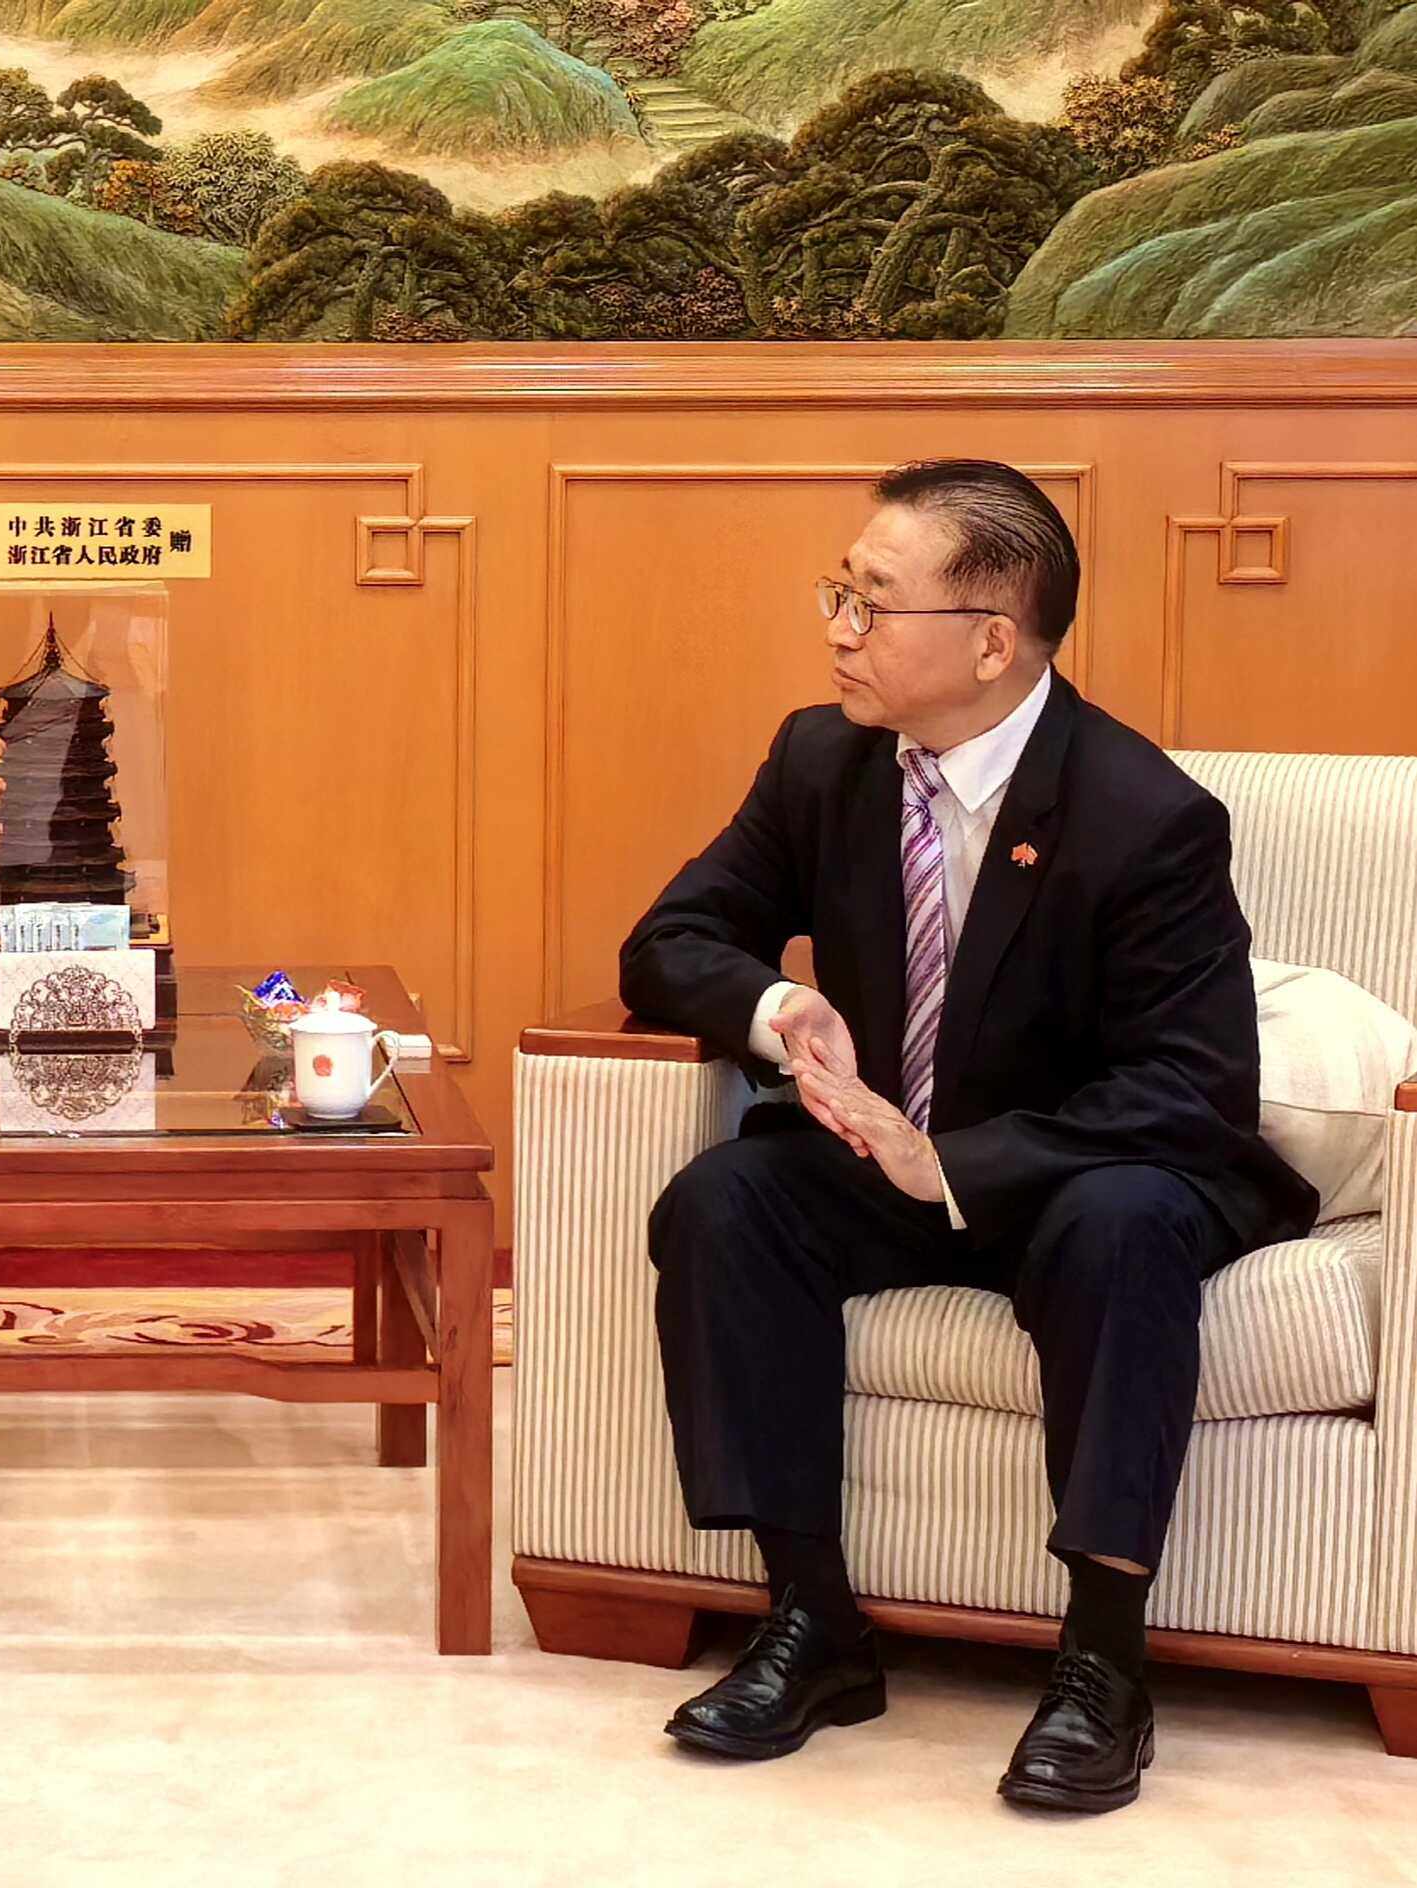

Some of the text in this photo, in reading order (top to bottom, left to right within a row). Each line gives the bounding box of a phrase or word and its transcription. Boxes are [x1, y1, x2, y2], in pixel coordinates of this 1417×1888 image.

[8, 515, 162, 538] 中共浙江省委
[169, 529, 192, 553] 赠
[7, 544, 162, 566] 浙江省人民政府
